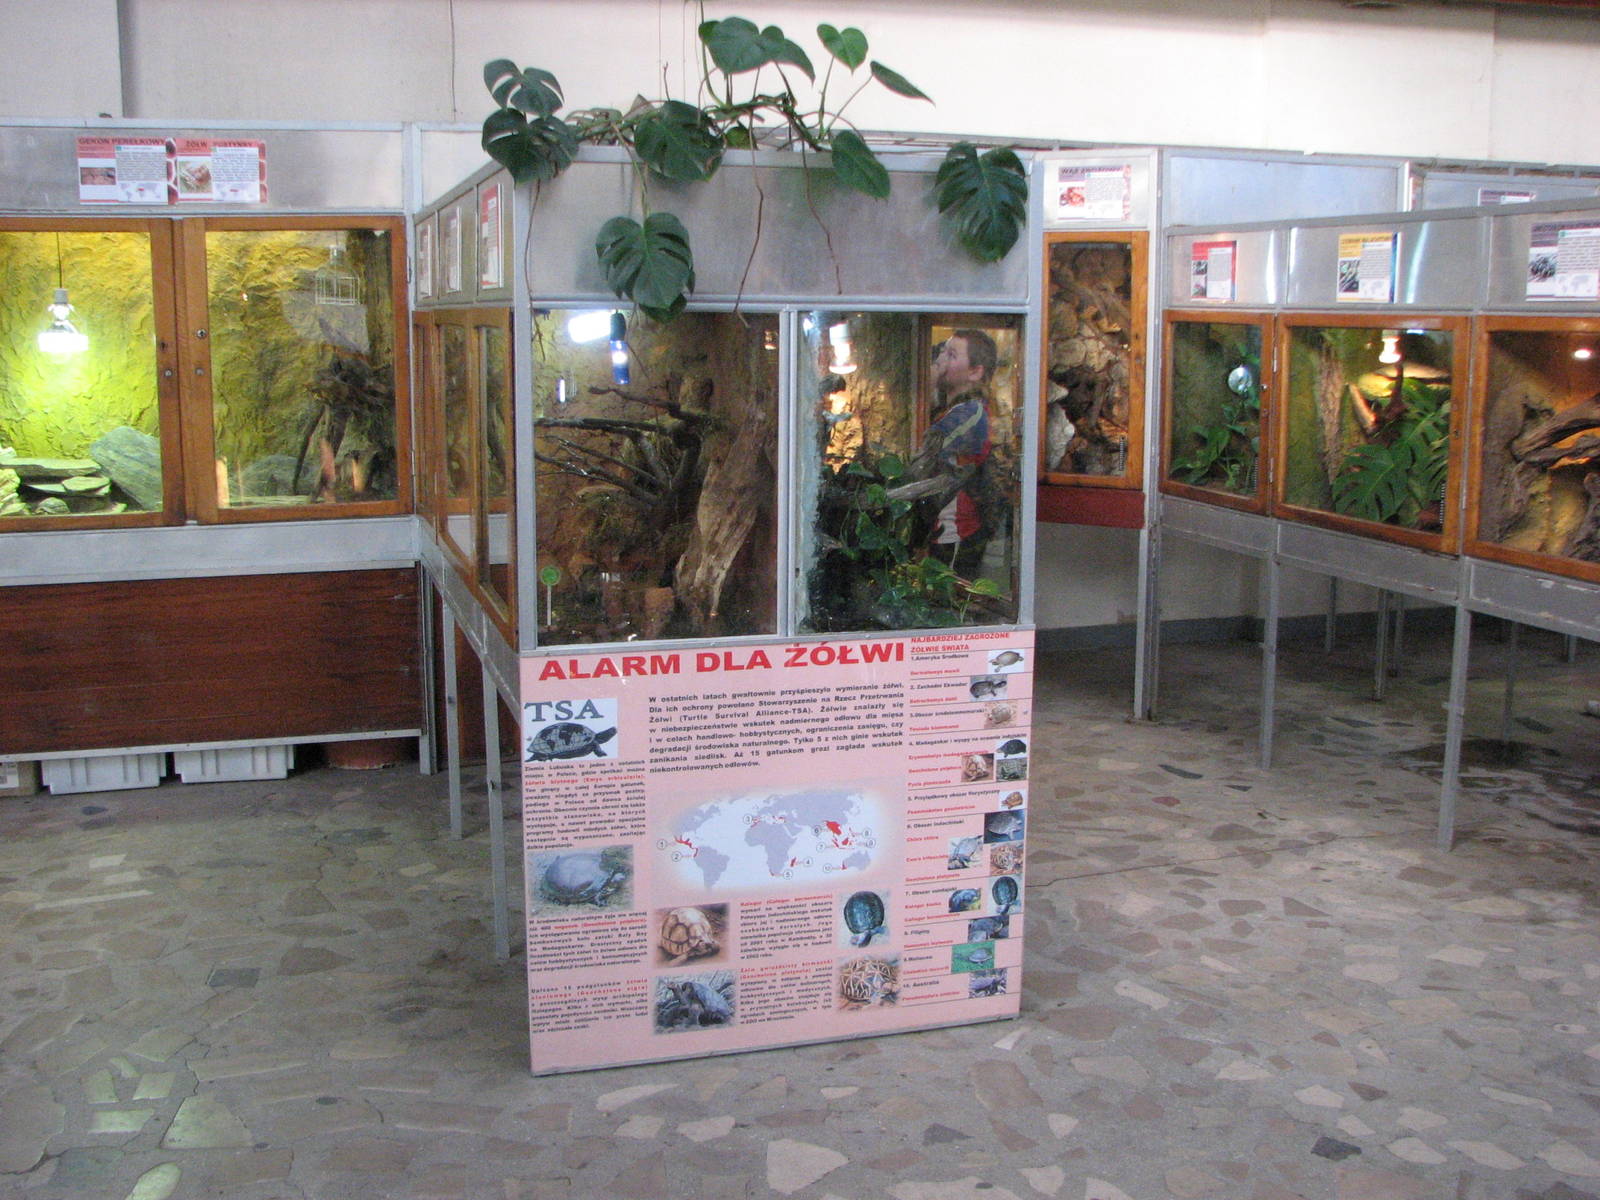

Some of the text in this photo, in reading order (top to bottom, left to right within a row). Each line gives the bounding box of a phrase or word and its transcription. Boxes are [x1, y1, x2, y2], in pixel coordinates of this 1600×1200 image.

[911, 632, 1010, 642] NAJBARDZIEJ ZAGROŻONE
[538, 641, 904, 680] ALARM DLA ŻÓŁWI
[524, 700, 604, 722] TSA
[716, 712, 748, 720] Survival
[650, 744, 692, 754] degradacji
[650, 756, 688, 764] zanikania
